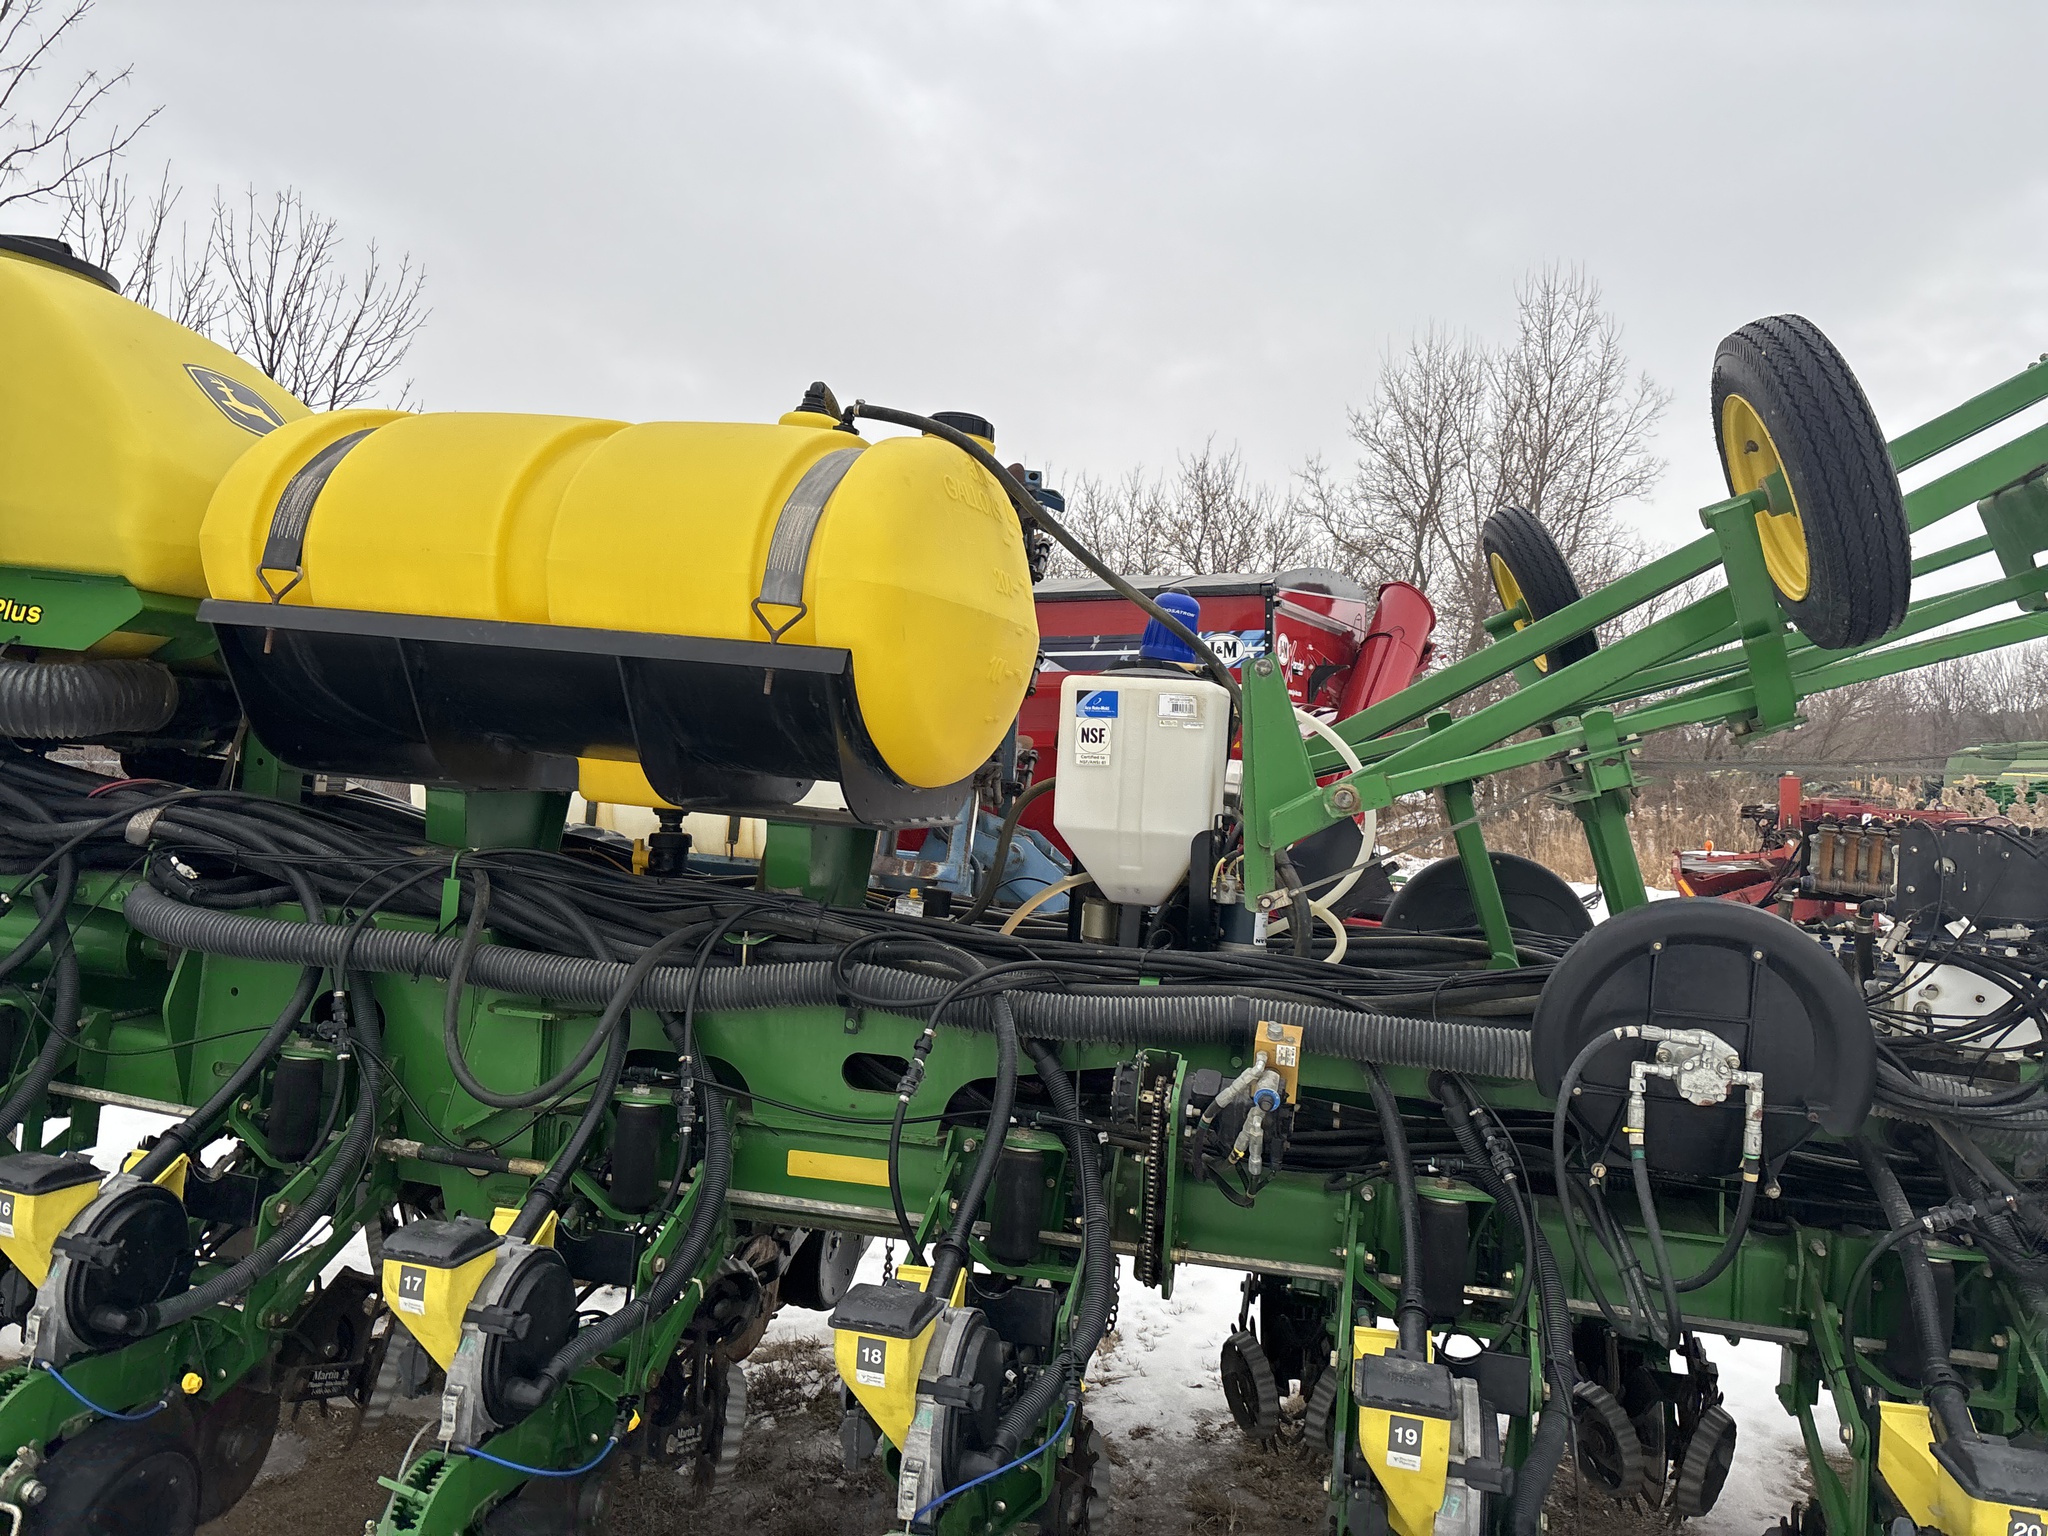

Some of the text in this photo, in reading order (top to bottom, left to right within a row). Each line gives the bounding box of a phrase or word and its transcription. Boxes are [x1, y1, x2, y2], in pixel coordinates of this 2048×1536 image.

[1081, 727, 1106, 744] NSF
[403, 1275, 423, 1292] 17
[861, 1347, 882, 1365] 18
[1394, 1426, 1418, 1446] 19
[1440, 1494, 1460, 1518] 19
[2012, 1522, 2042, 1536] 20
